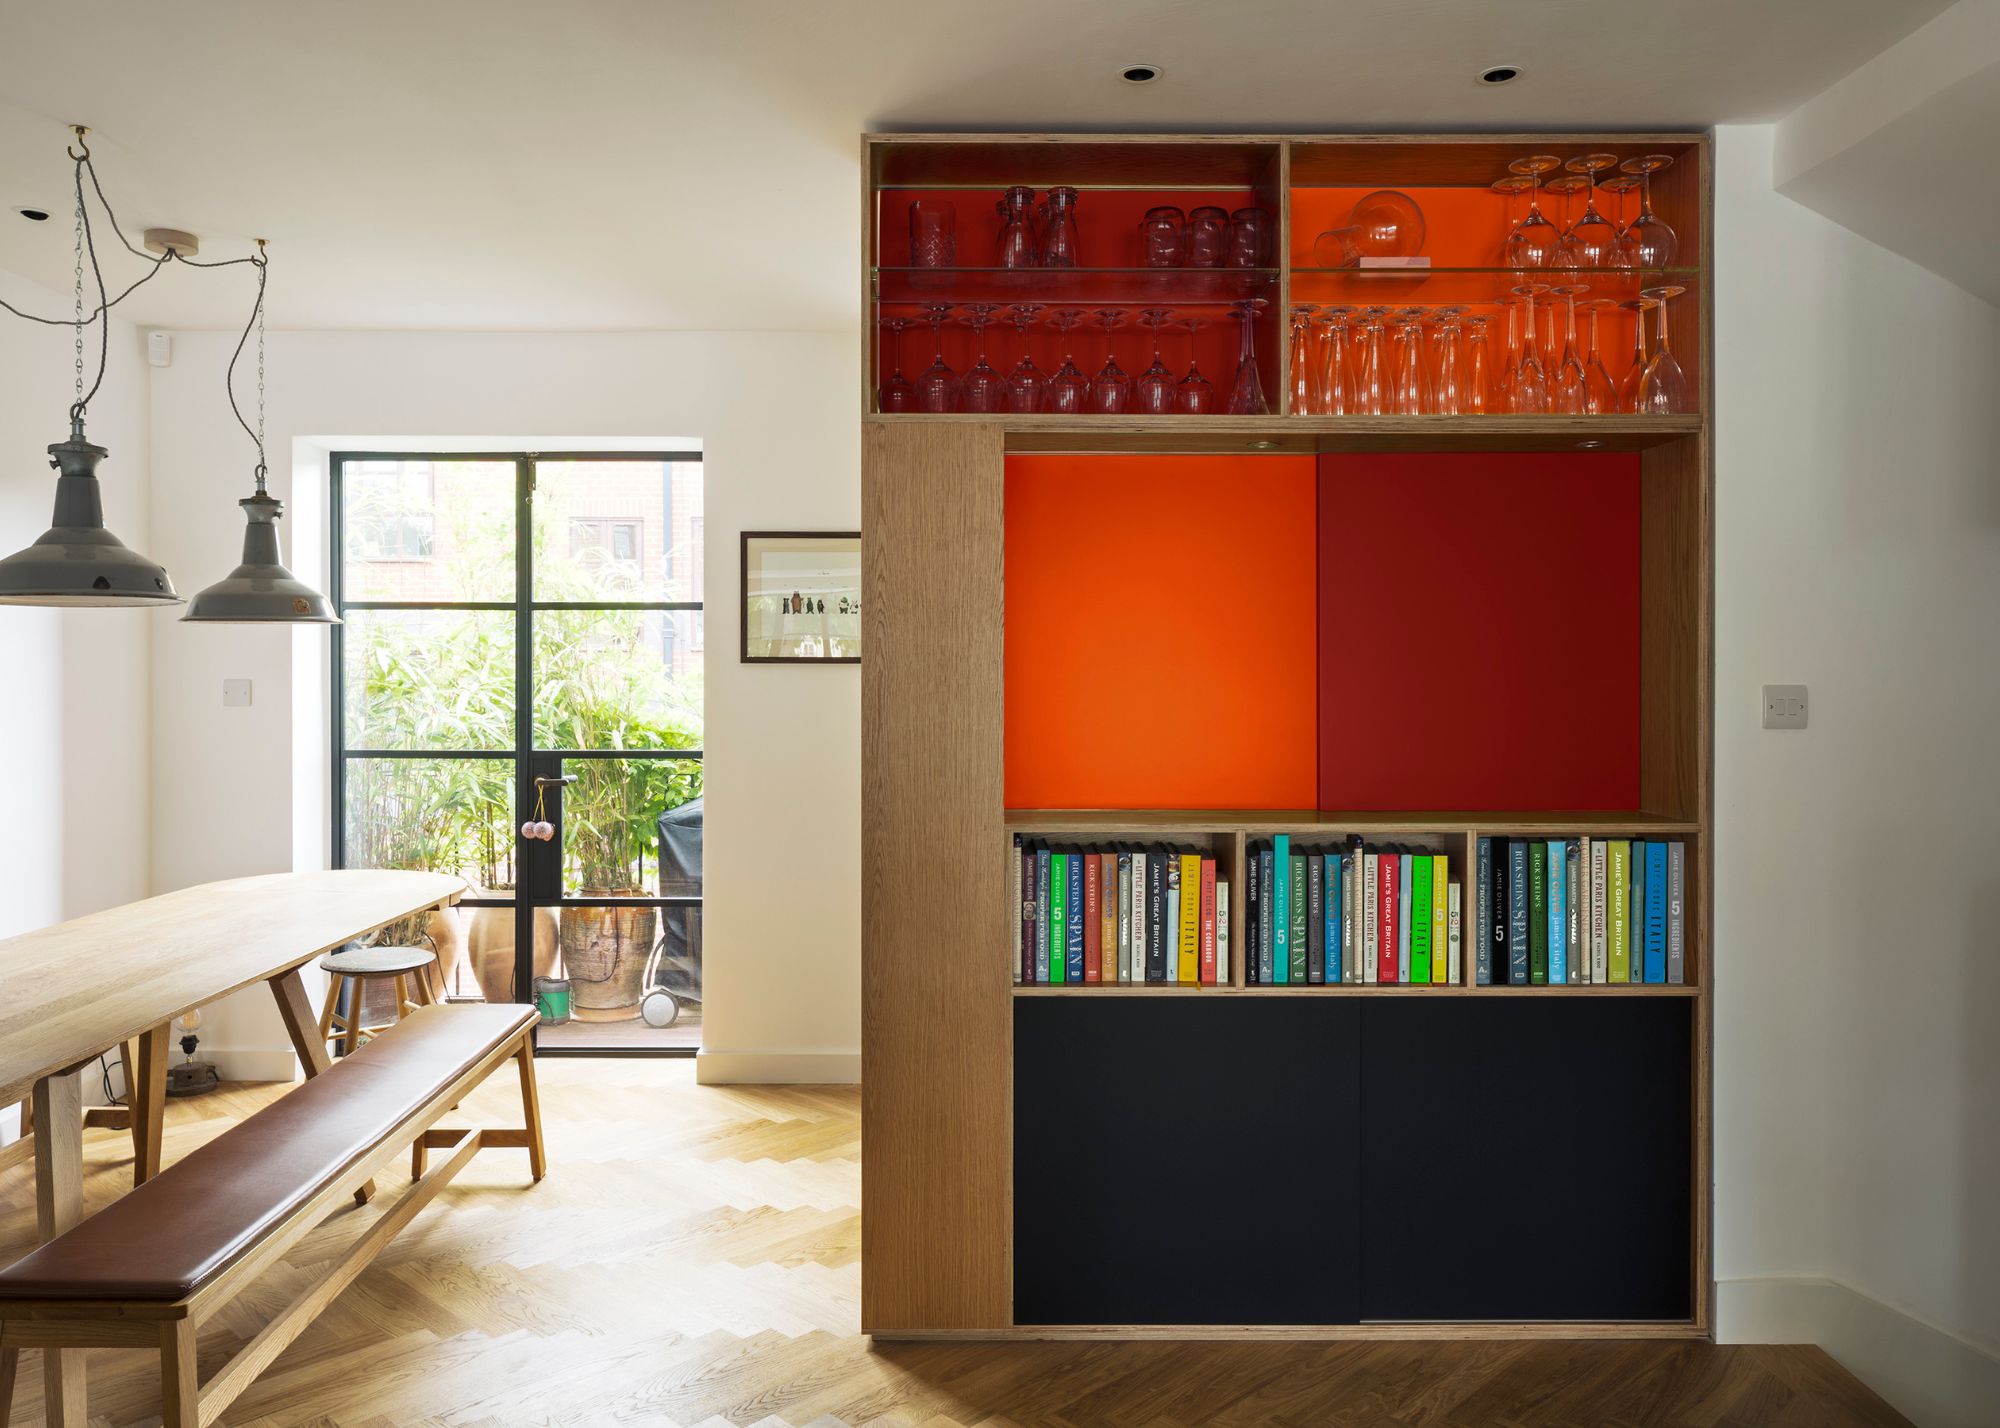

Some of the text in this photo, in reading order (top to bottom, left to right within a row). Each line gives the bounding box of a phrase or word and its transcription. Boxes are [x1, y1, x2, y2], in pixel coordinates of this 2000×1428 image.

[1595, 855, 1603, 880] LITTLE
[1054, 907, 1061, 920] 5
[1552, 881, 1560, 912] OLIVER
[1581, 880, 1589, 935] GARDENER
[1672, 901, 1680, 915] 5
[1436, 908, 1443, 921] 5
[1069, 915, 1082, 965] SPAIN
[1184, 920, 1194, 955] ITALY
[1278, 929, 1285, 944] 5
[1293, 916, 1305, 966] SPAIN
[1328, 922, 1336, 969] jamie's italy
[1417, 922, 1426, 955] ITALY
[1496, 926, 1504, 941] 5
[1513, 910, 1526, 966] SPAIN
[1552, 916, 1561, 969] jamie's italy
[1650, 916, 1661, 953] ITALY
[1671, 920, 1679, 959] INGREDIENTS
[1106, 951, 1114, 968] italy
